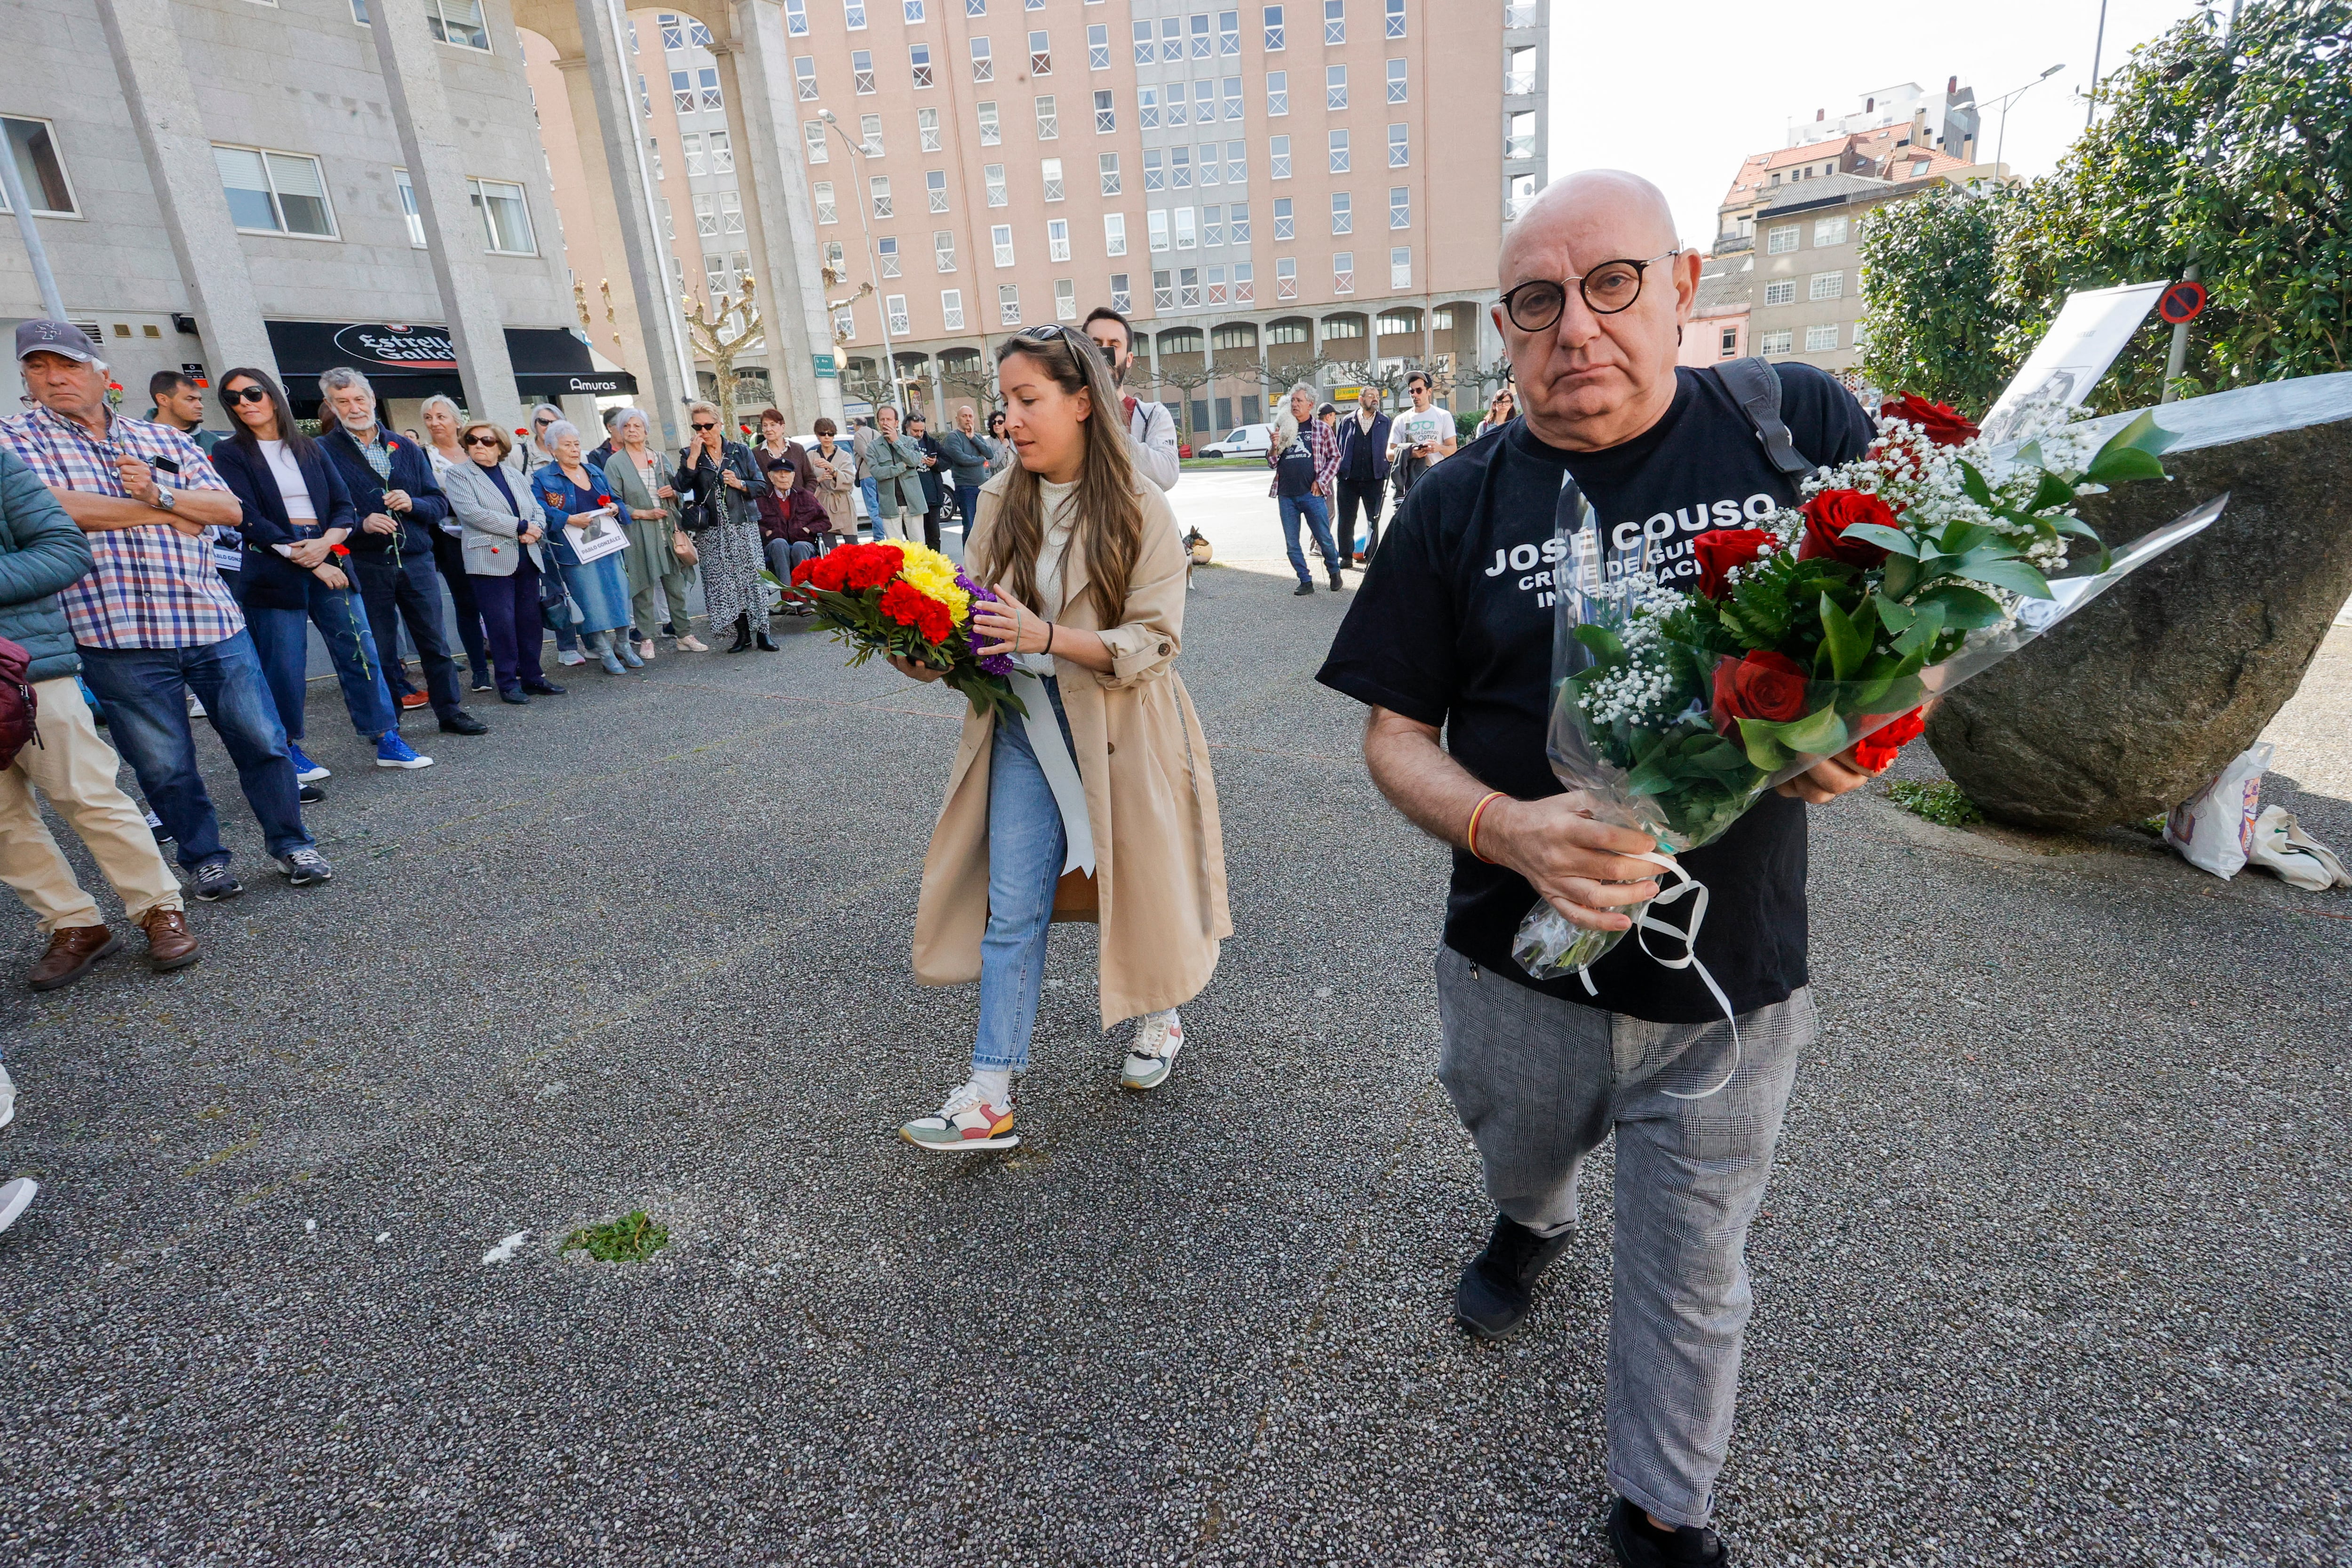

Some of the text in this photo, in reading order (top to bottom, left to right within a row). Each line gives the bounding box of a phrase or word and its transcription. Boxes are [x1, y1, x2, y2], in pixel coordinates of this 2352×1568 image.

[376, 348, 455, 359] Galici
[570, 378, 617, 390] Amuras
[1485, 493, 1775, 577] JOSÉ COUSO
[581, 536, 621, 555] PABLO GONZÁLEZ
[1606, 556, 1639, 576] DE
[1647, 539, 1695, 564] GUE
